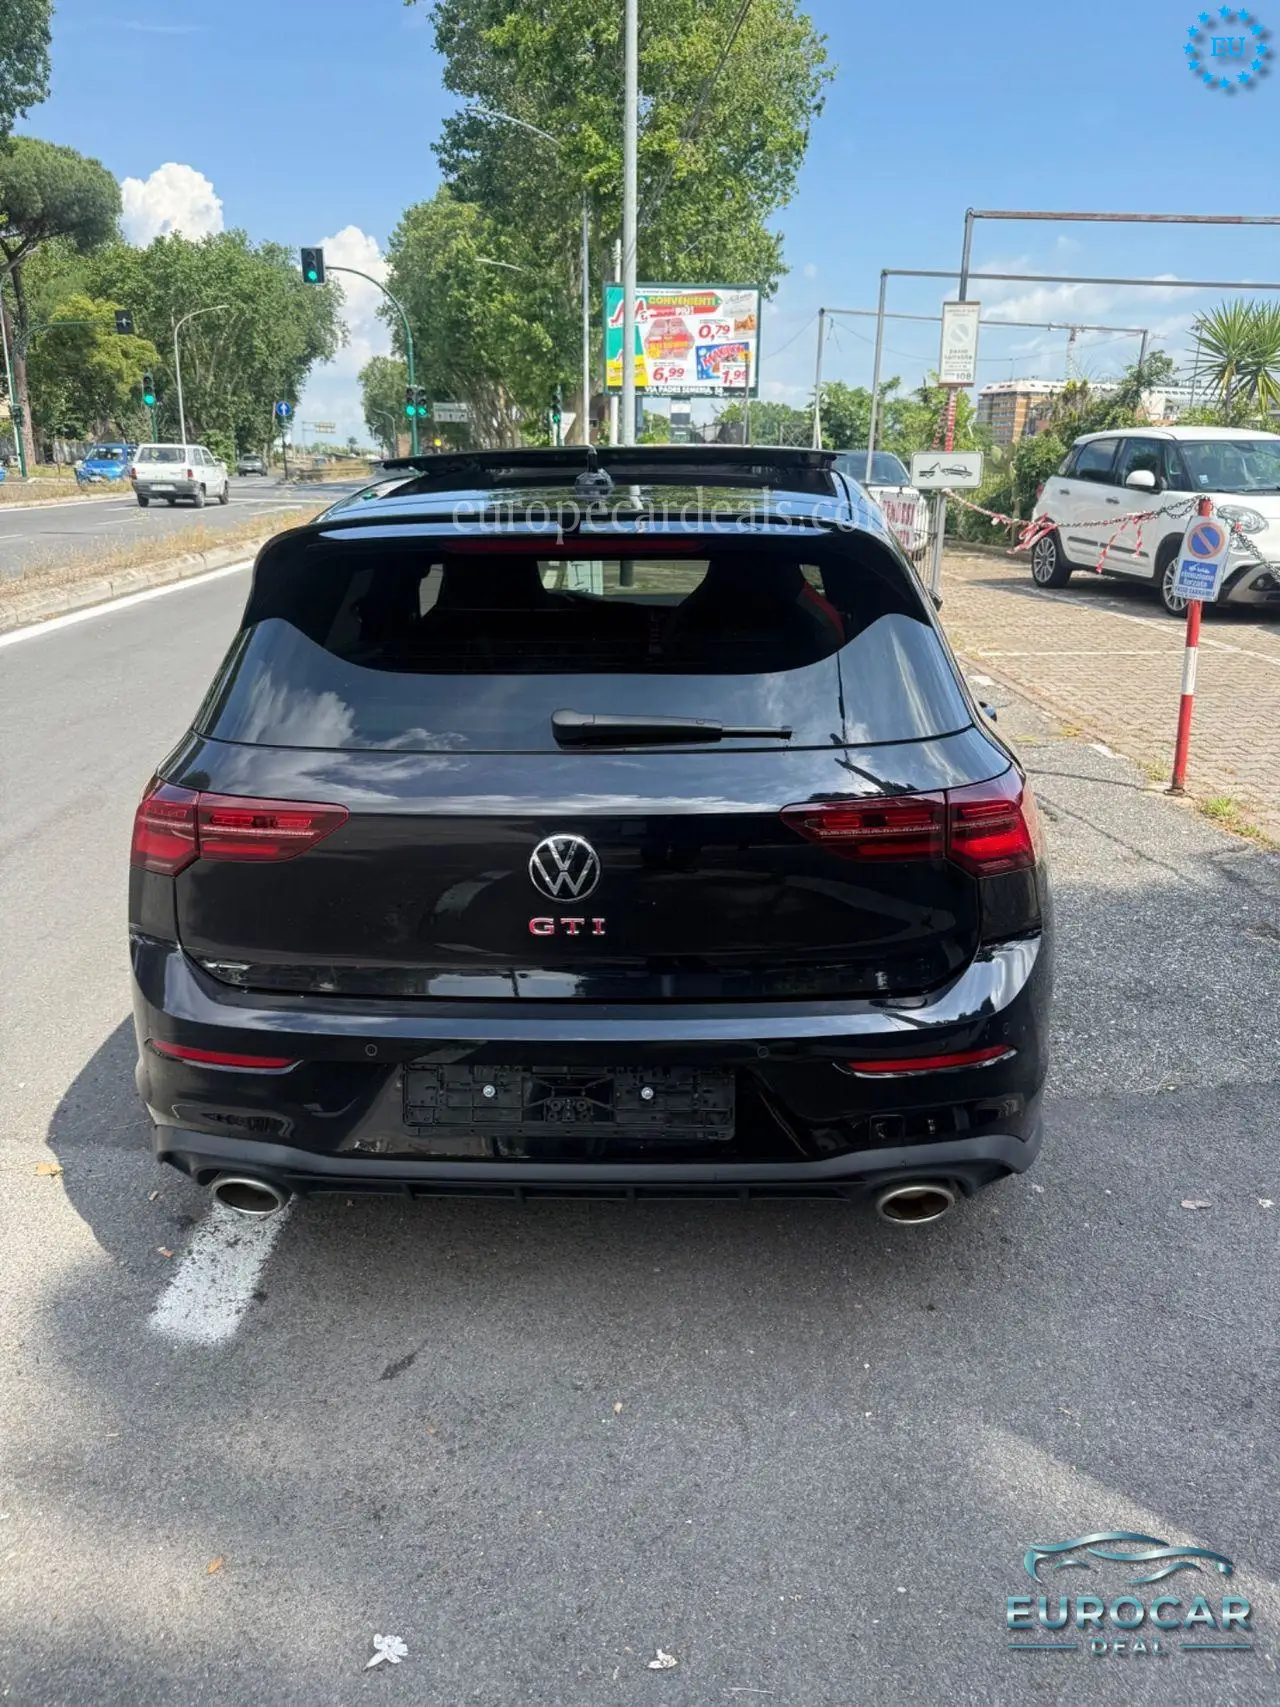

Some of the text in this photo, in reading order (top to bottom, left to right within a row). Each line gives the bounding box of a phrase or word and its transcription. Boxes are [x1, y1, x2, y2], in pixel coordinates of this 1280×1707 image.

[648, 295, 715, 306] CONVENIENTI
[699, 324, 730, 340] 0,79
[653, 366, 685, 383] 6,99
[529, 917, 605, 935] GTI
